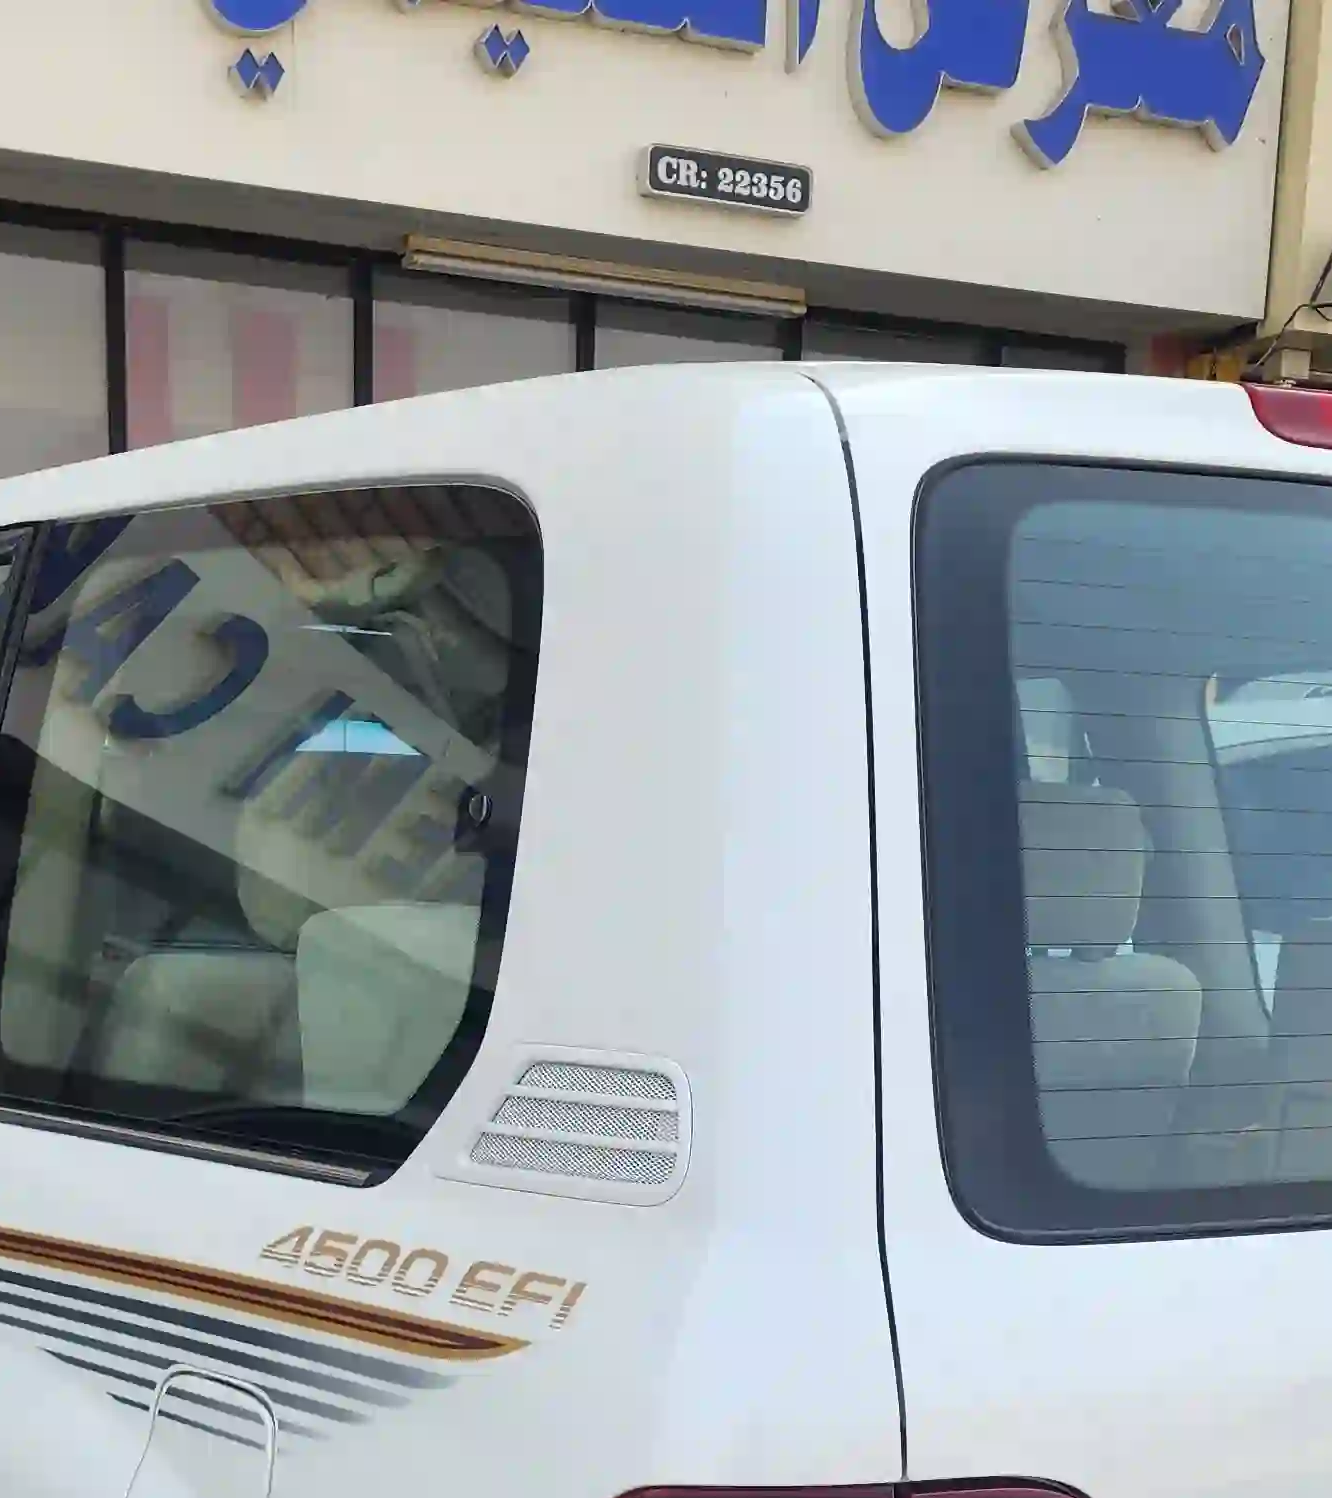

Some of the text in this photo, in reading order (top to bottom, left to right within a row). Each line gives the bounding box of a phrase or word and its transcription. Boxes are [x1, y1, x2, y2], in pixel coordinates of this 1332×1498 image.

[657, 155, 803, 204] CR: 22356
[260, 1225, 587, 1331] 4500 EFI
